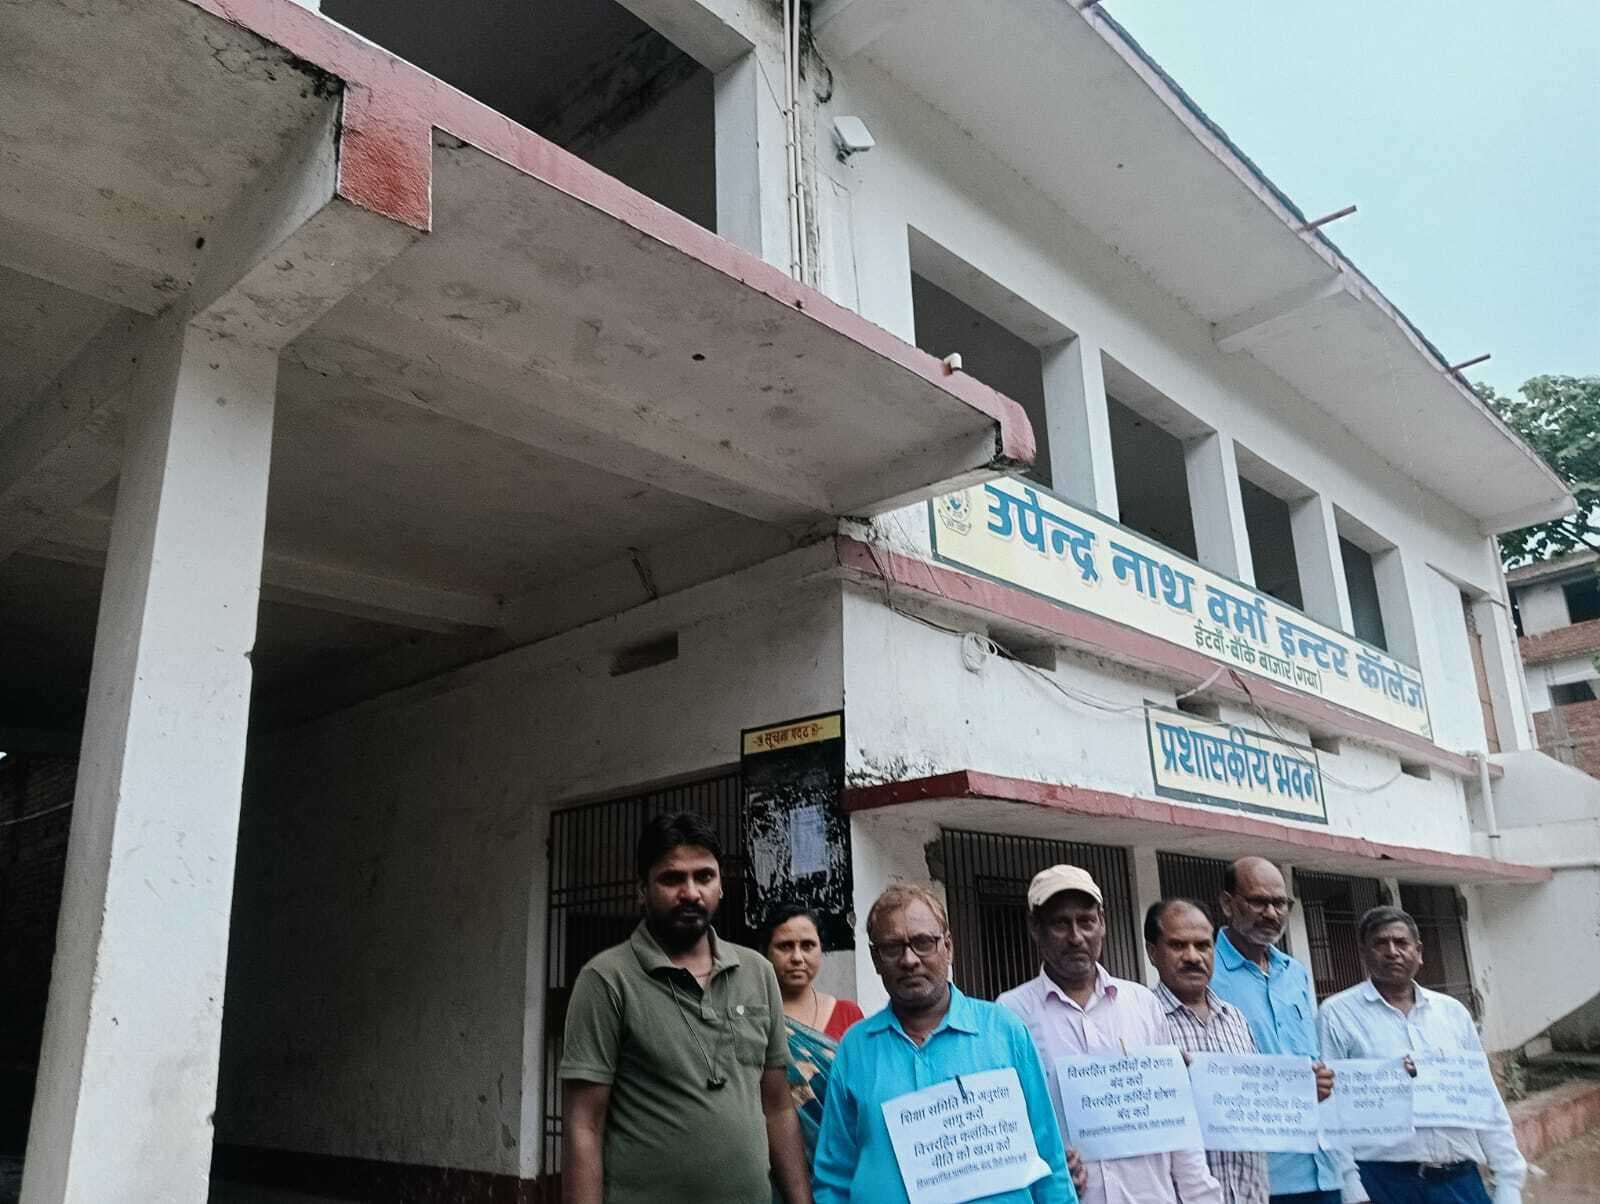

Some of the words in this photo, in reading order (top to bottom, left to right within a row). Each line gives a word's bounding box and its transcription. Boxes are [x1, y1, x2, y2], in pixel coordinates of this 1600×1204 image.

[984, 484, 1098, 583] उपेन्द्र
[1110, 541, 1194, 613] नाथ
[1205, 585, 1267, 643] वर्मा
[1276, 616, 1348, 678] इन्टर
[1355, 647, 1423, 710] कॉलेज
[1156, 722, 1271, 793] प्रशासकीय
[1272, 752, 1319, 803] भवन
